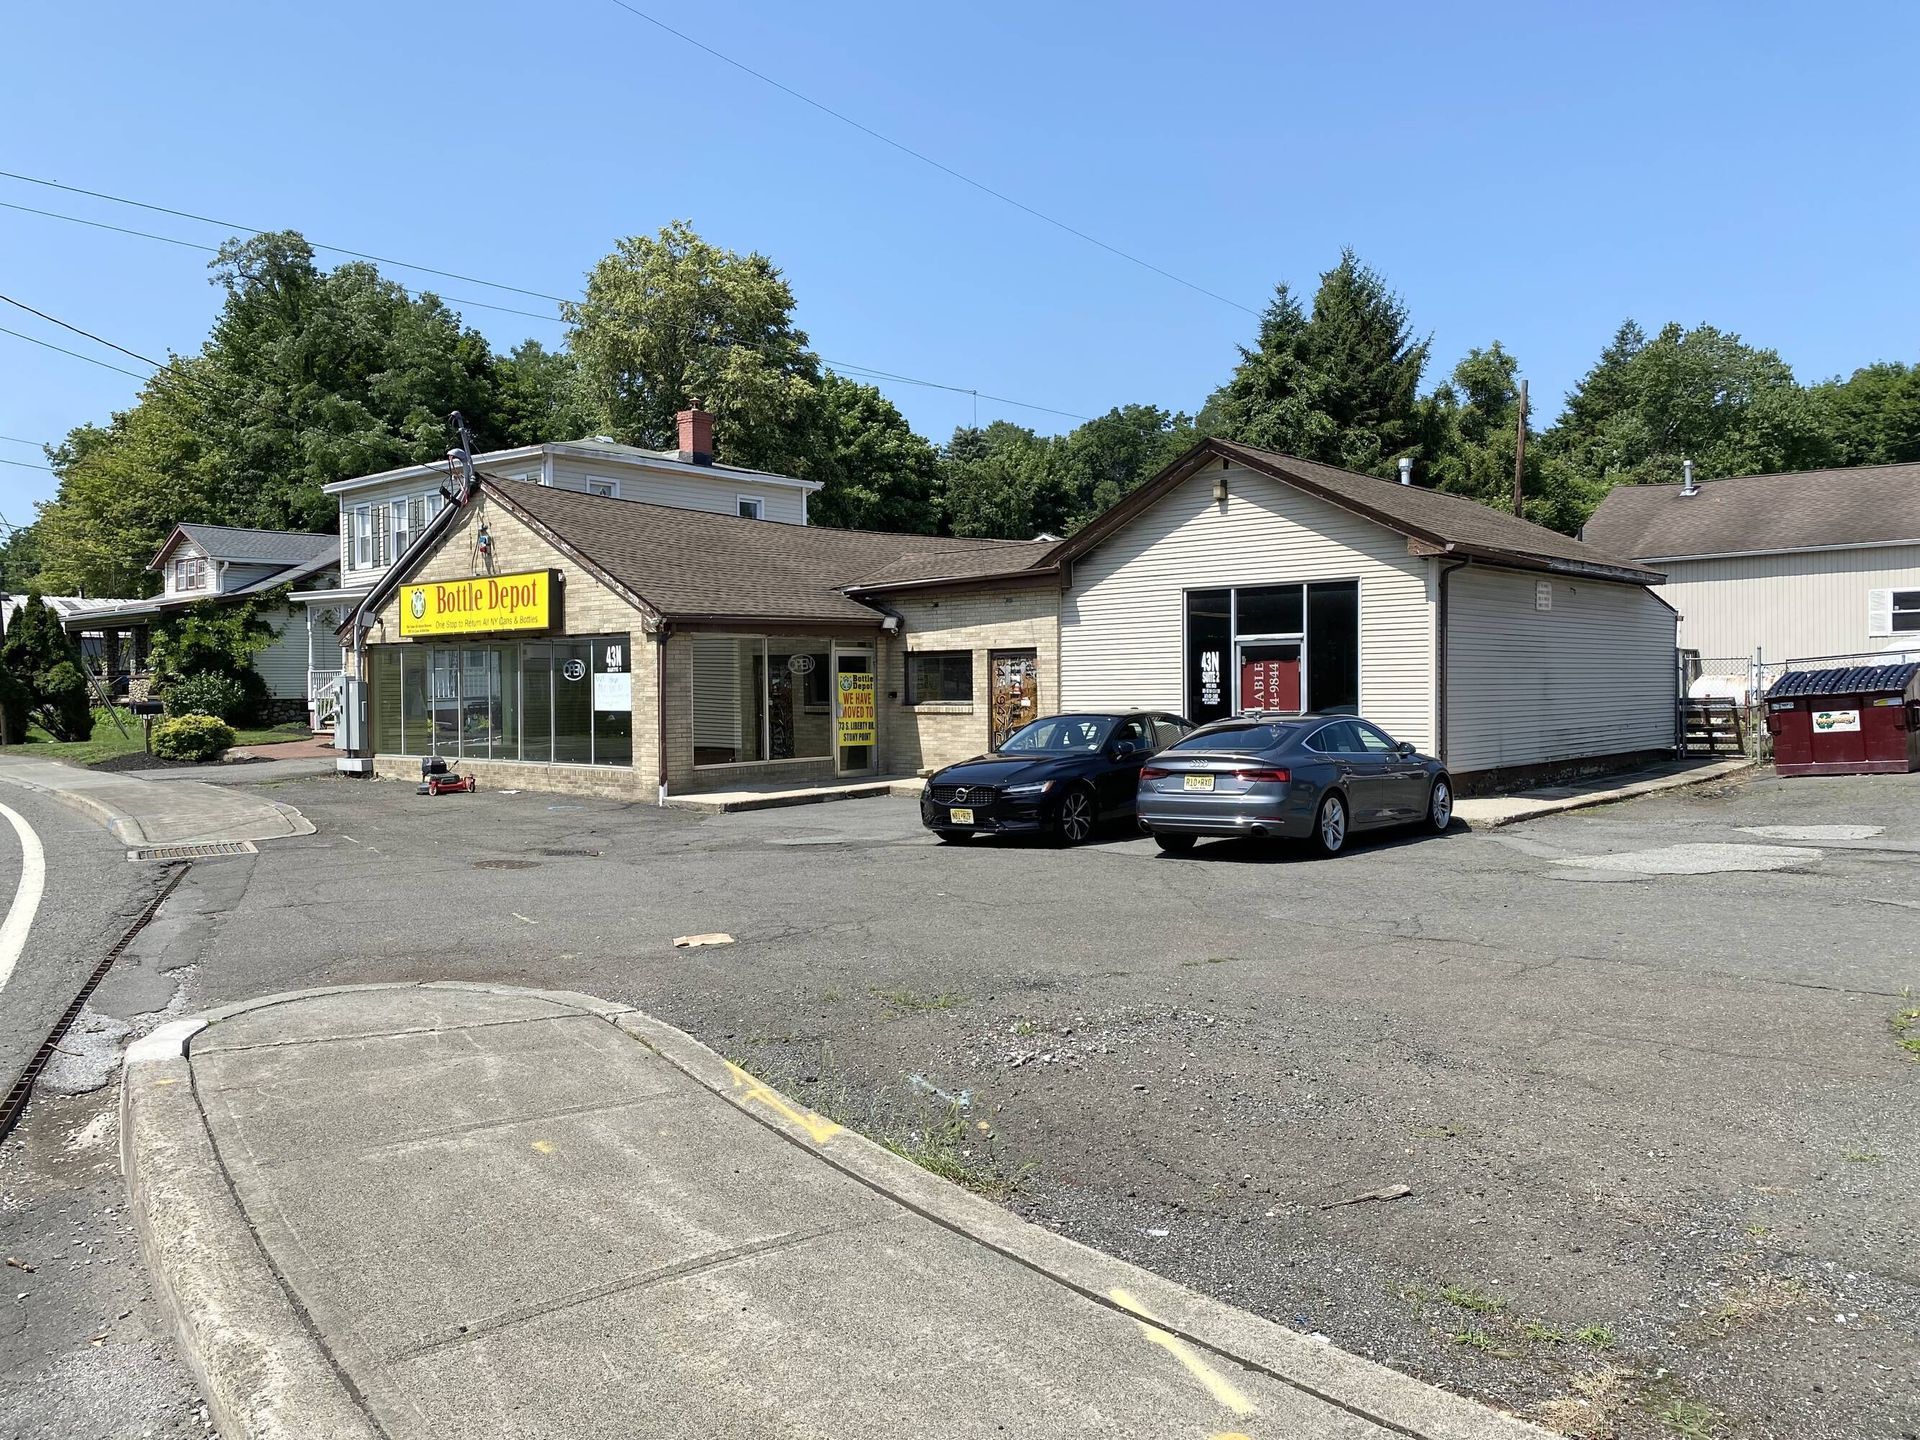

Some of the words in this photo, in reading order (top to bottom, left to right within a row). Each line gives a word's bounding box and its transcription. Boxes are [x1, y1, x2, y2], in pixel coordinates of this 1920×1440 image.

[436, 583, 483, 614] Bottle
[488, 579, 538, 613] Depot
[436, 621, 445, 629] One
[446, 620, 458, 629] Stop
[458, 620, 464, 628] to
[465, 618, 482, 628] Return
[490, 617, 499, 626] NY
[500, 616, 513, 626] Cans
[513, 615, 519, 624] &
[519, 615, 538, 624] Bottles
[605, 645, 622, 667] 43N
[1201, 651, 1220, 671] 43N
[1202, 671, 1215, 683] SUITE
[853, 683, 873, 691] Depot
[1254, 662, 1265, 711] LABLE
[1269, 662, 1280, 711] 14-9844
[843, 693, 854, 704] WE
[855, 693, 871, 704] HAVE
[865, 706, 874, 718] TO
[850, 721, 868, 730] LIBERTY
[843, 733, 858, 742] STONY
[859, 733, 871, 742] POINT
